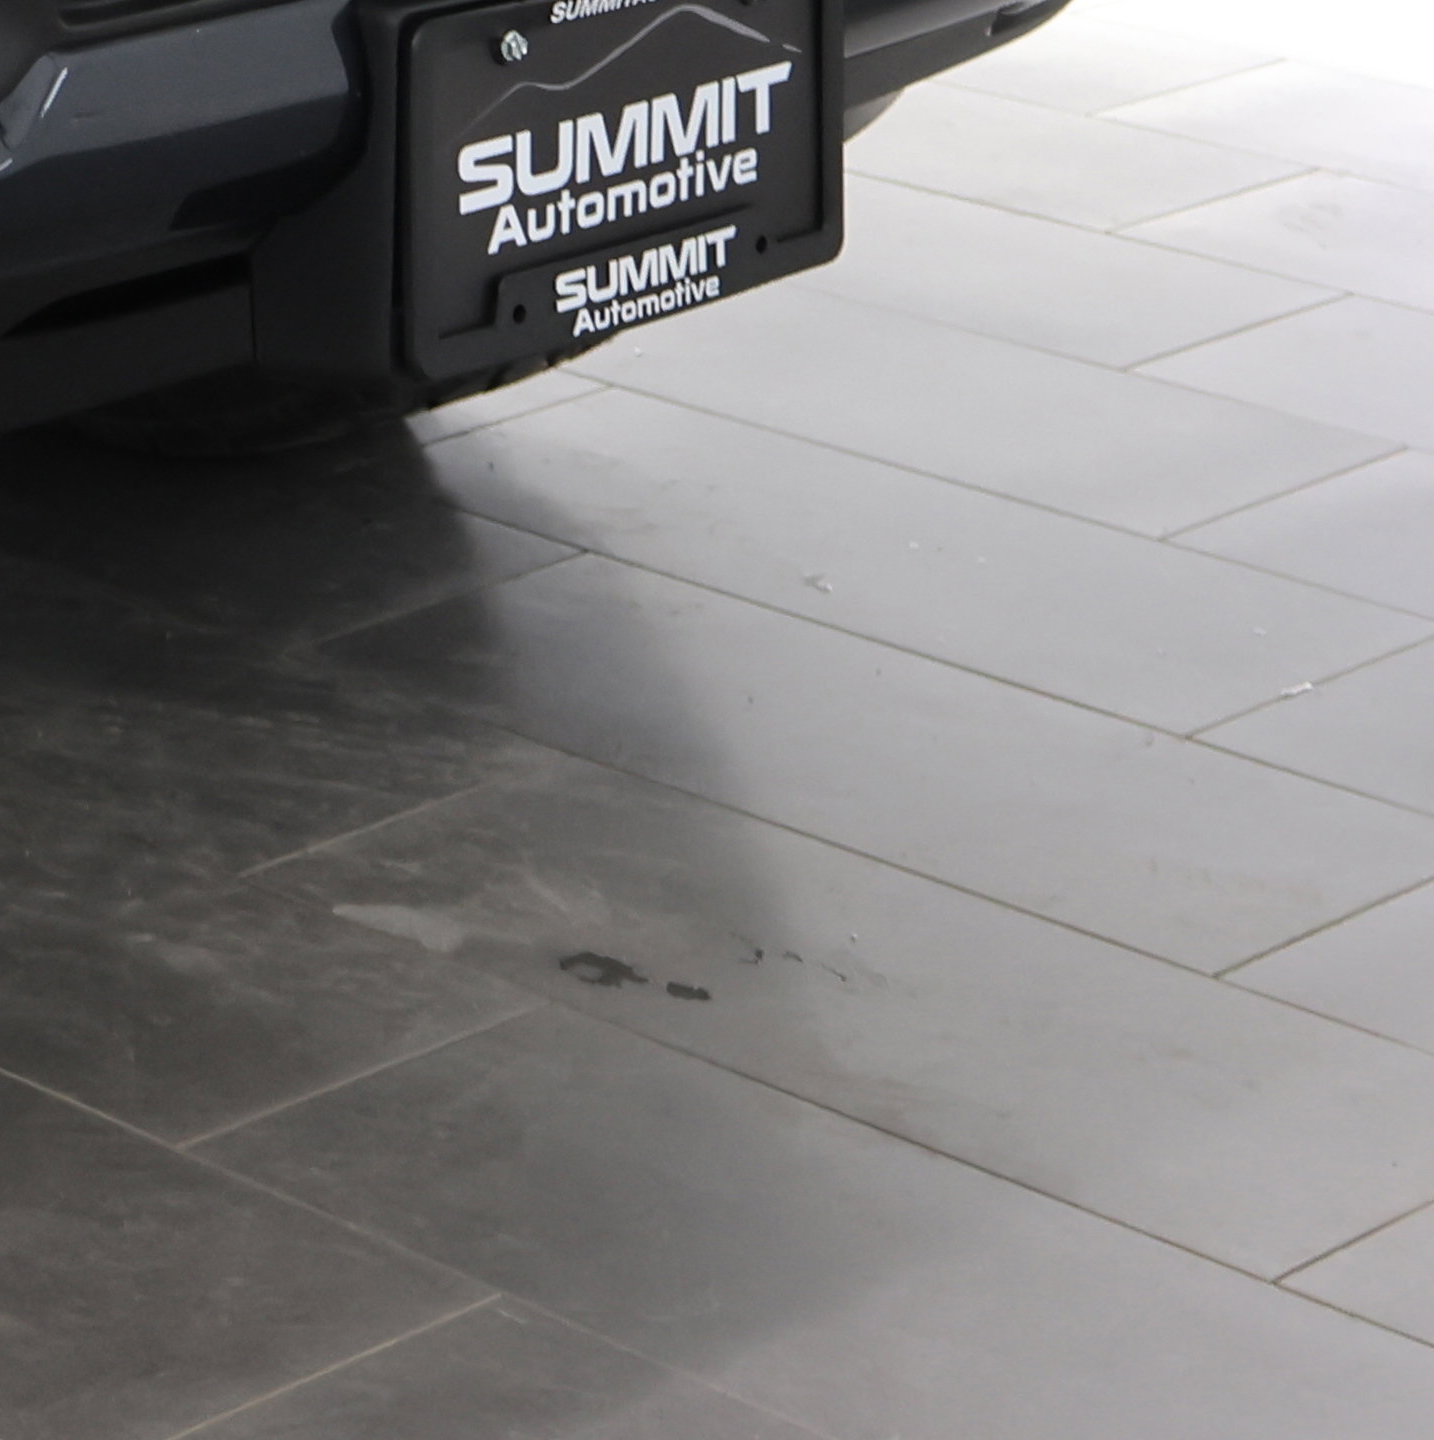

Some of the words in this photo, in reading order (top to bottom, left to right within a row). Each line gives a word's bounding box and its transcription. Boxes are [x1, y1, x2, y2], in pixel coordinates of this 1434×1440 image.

[457, 60, 793, 216] SUMMIT
[486, 147, 759, 255] Automotive
[554, 225, 738, 313] SUMMIT
[572, 275, 721, 338] Automotive
